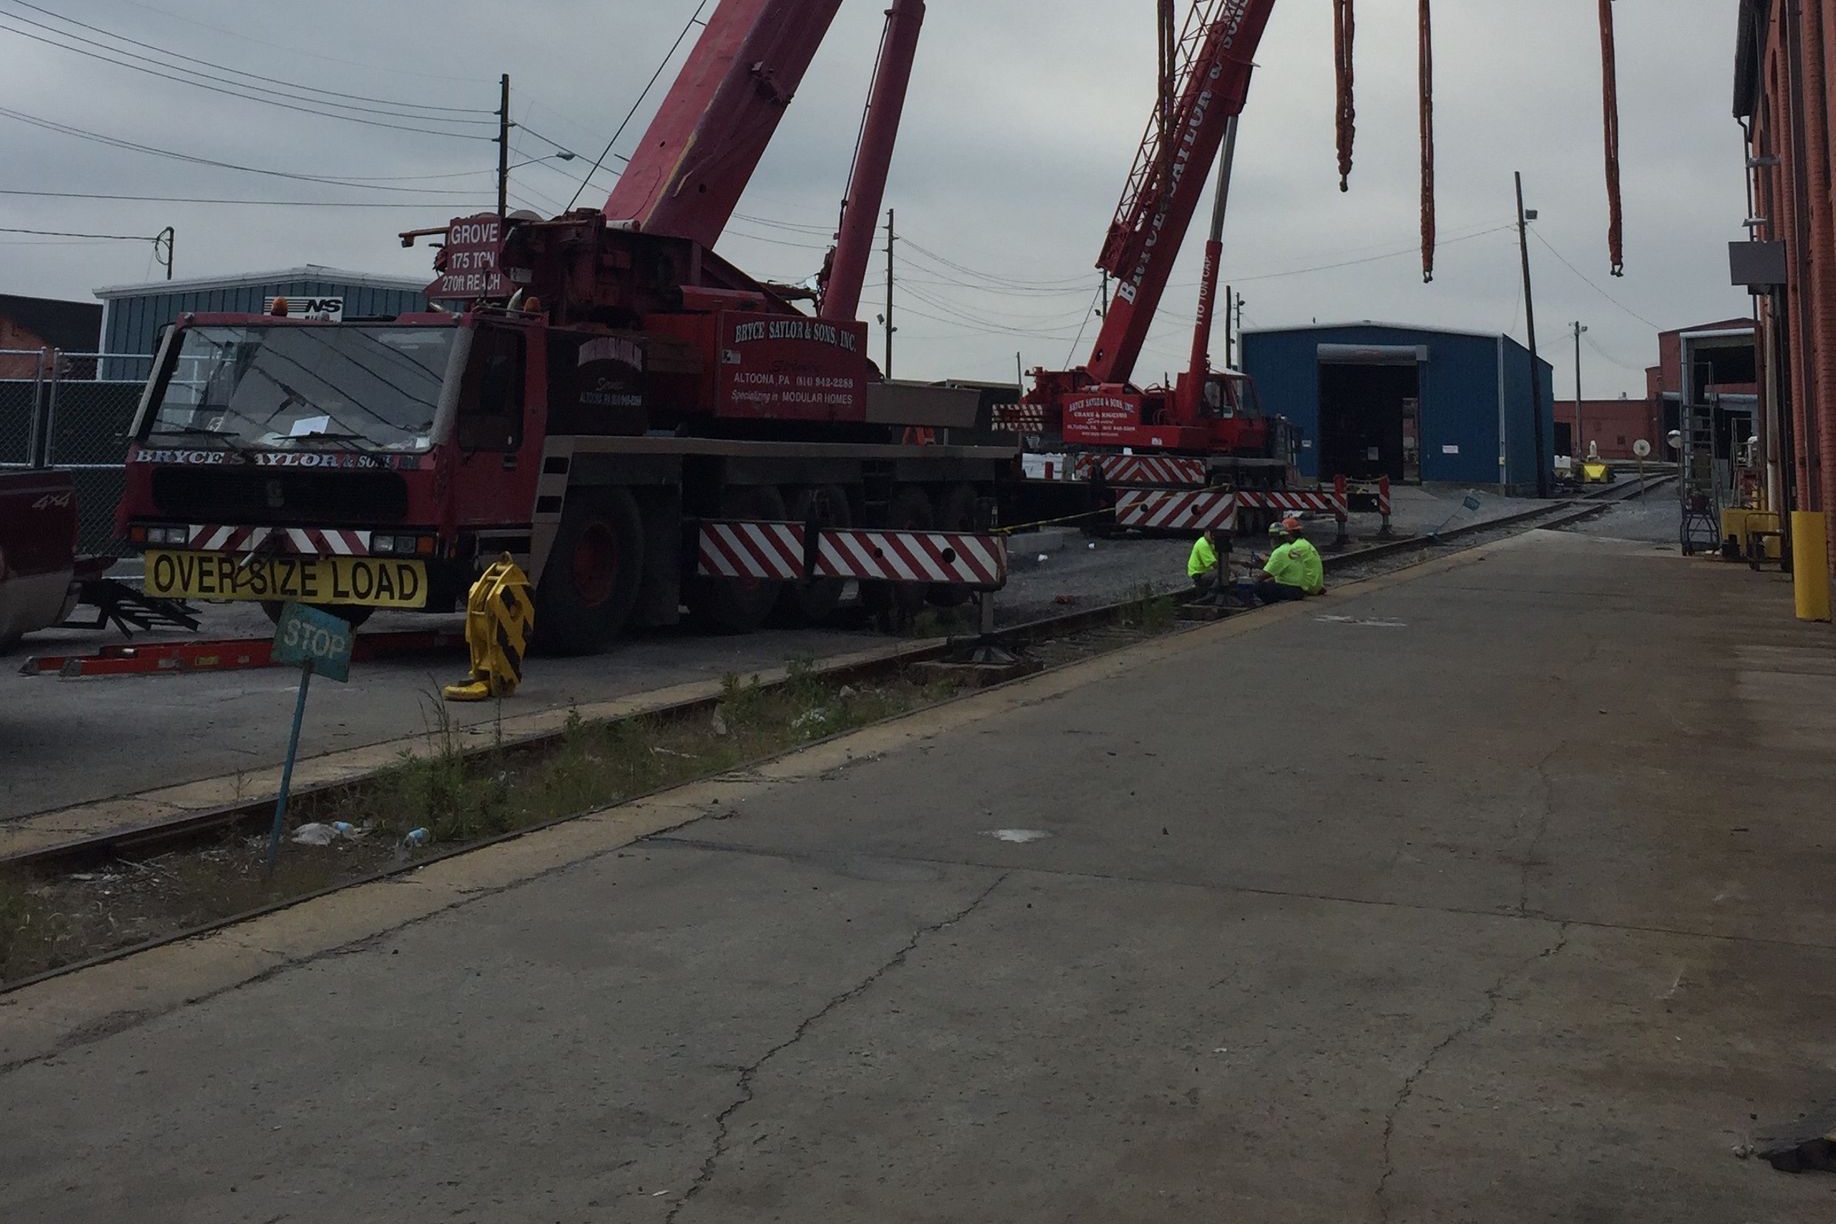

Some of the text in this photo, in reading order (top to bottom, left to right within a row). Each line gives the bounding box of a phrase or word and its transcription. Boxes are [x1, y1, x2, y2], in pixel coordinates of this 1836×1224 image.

[451, 223, 499, 244] GROVE
[451, 251, 495, 269] 175 TON
[442, 275, 465, 292] 270ft
[305, 299, 343, 313] NS
[734, 321, 766, 344] BRYCE
[768, 320, 804, 339] SAYLOR
[804, 322, 812, 340] &
[840, 329, 857, 353] INC.
[782, 391, 823, 404] MODULAR
[824, 393, 853, 405] HOMES
[135, 450, 225, 465] BRYCE
[153, 554, 420, 602] OVER SIZE LOAD
[284, 619, 346, 658] STOP
